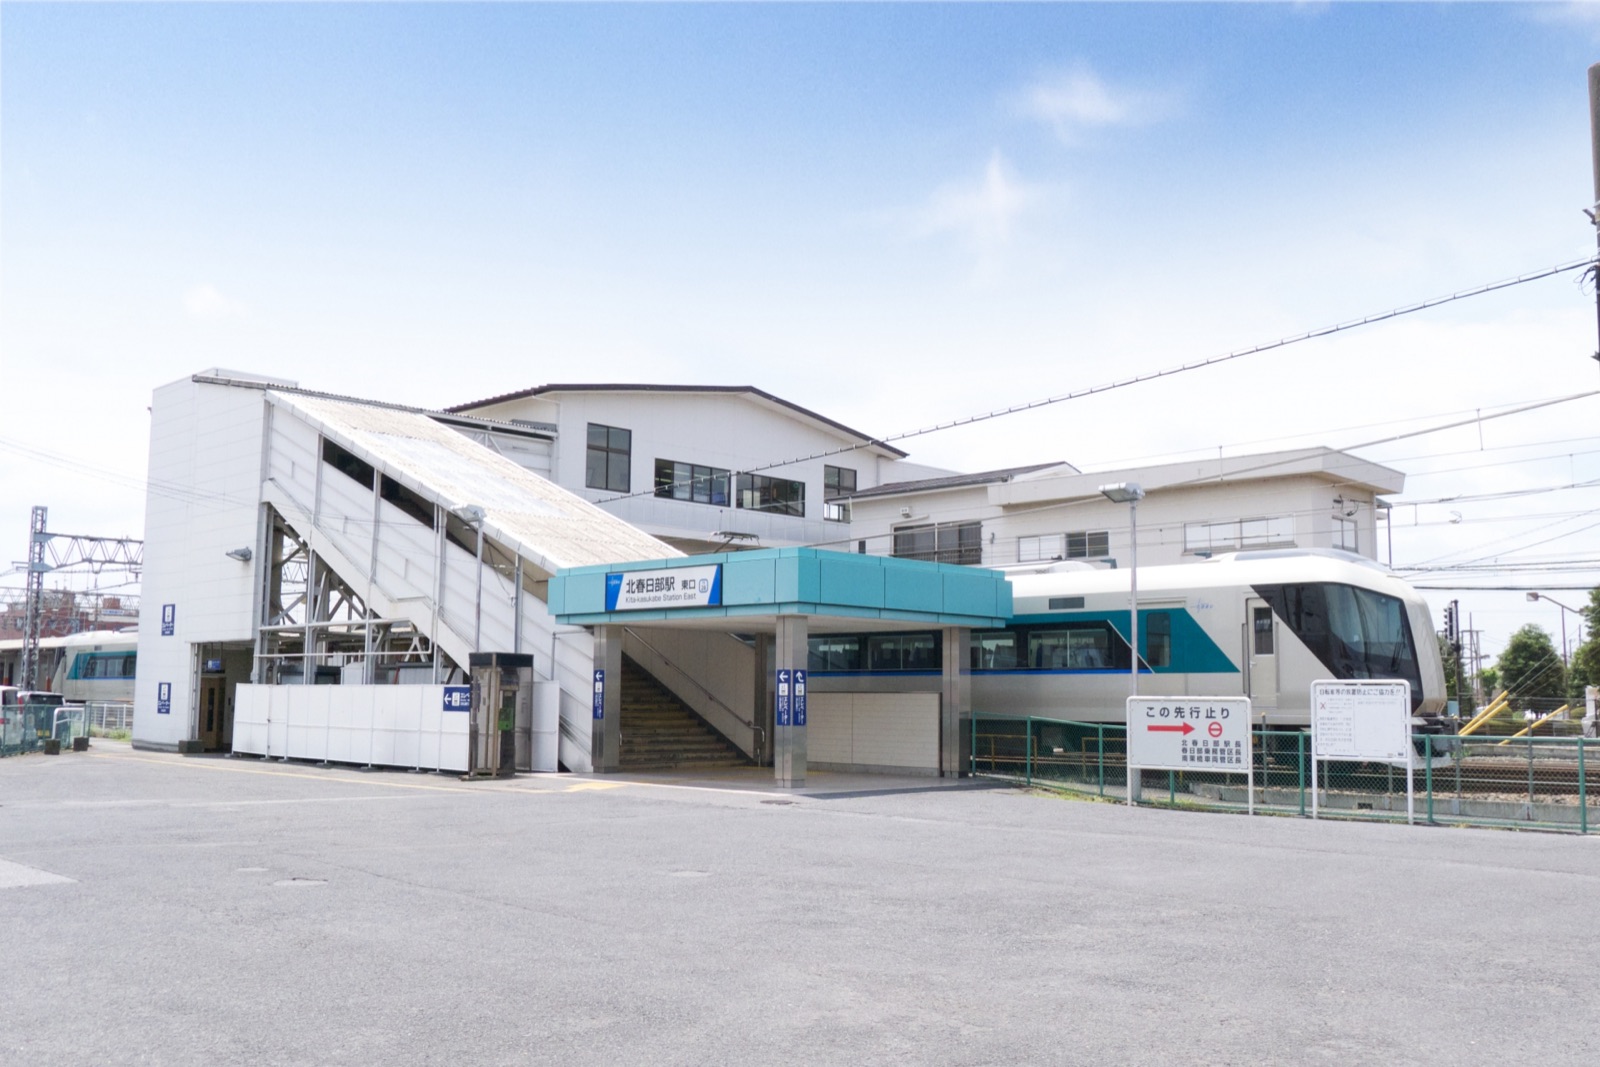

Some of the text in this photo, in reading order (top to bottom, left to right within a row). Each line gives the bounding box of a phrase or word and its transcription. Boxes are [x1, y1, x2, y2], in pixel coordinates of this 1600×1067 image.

[626, 576, 696, 594] 北春日部駅 東口
[626, 592, 696, 604] Kita-kasukabe Station East
[1146, 706, 1230, 719] この先行止り
